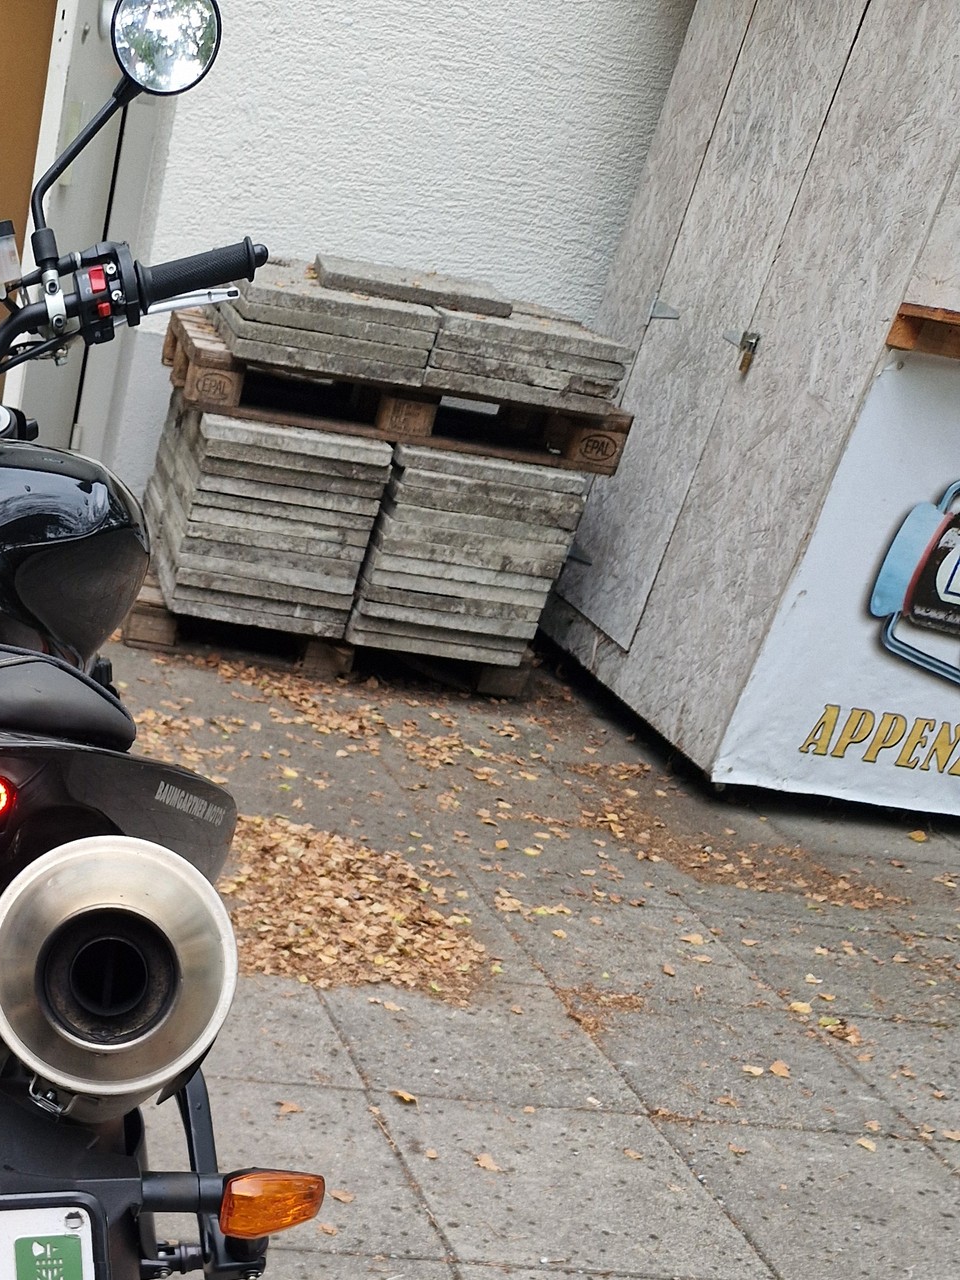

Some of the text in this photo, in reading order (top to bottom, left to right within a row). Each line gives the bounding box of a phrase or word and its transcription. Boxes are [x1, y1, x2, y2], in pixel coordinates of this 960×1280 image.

[202, 378, 227, 396] EPAL
[584, 438, 610, 456] EPAL
[798, 703, 960, 776] APPEN
[154, 780, 208, 819] BAUMGARTNER
